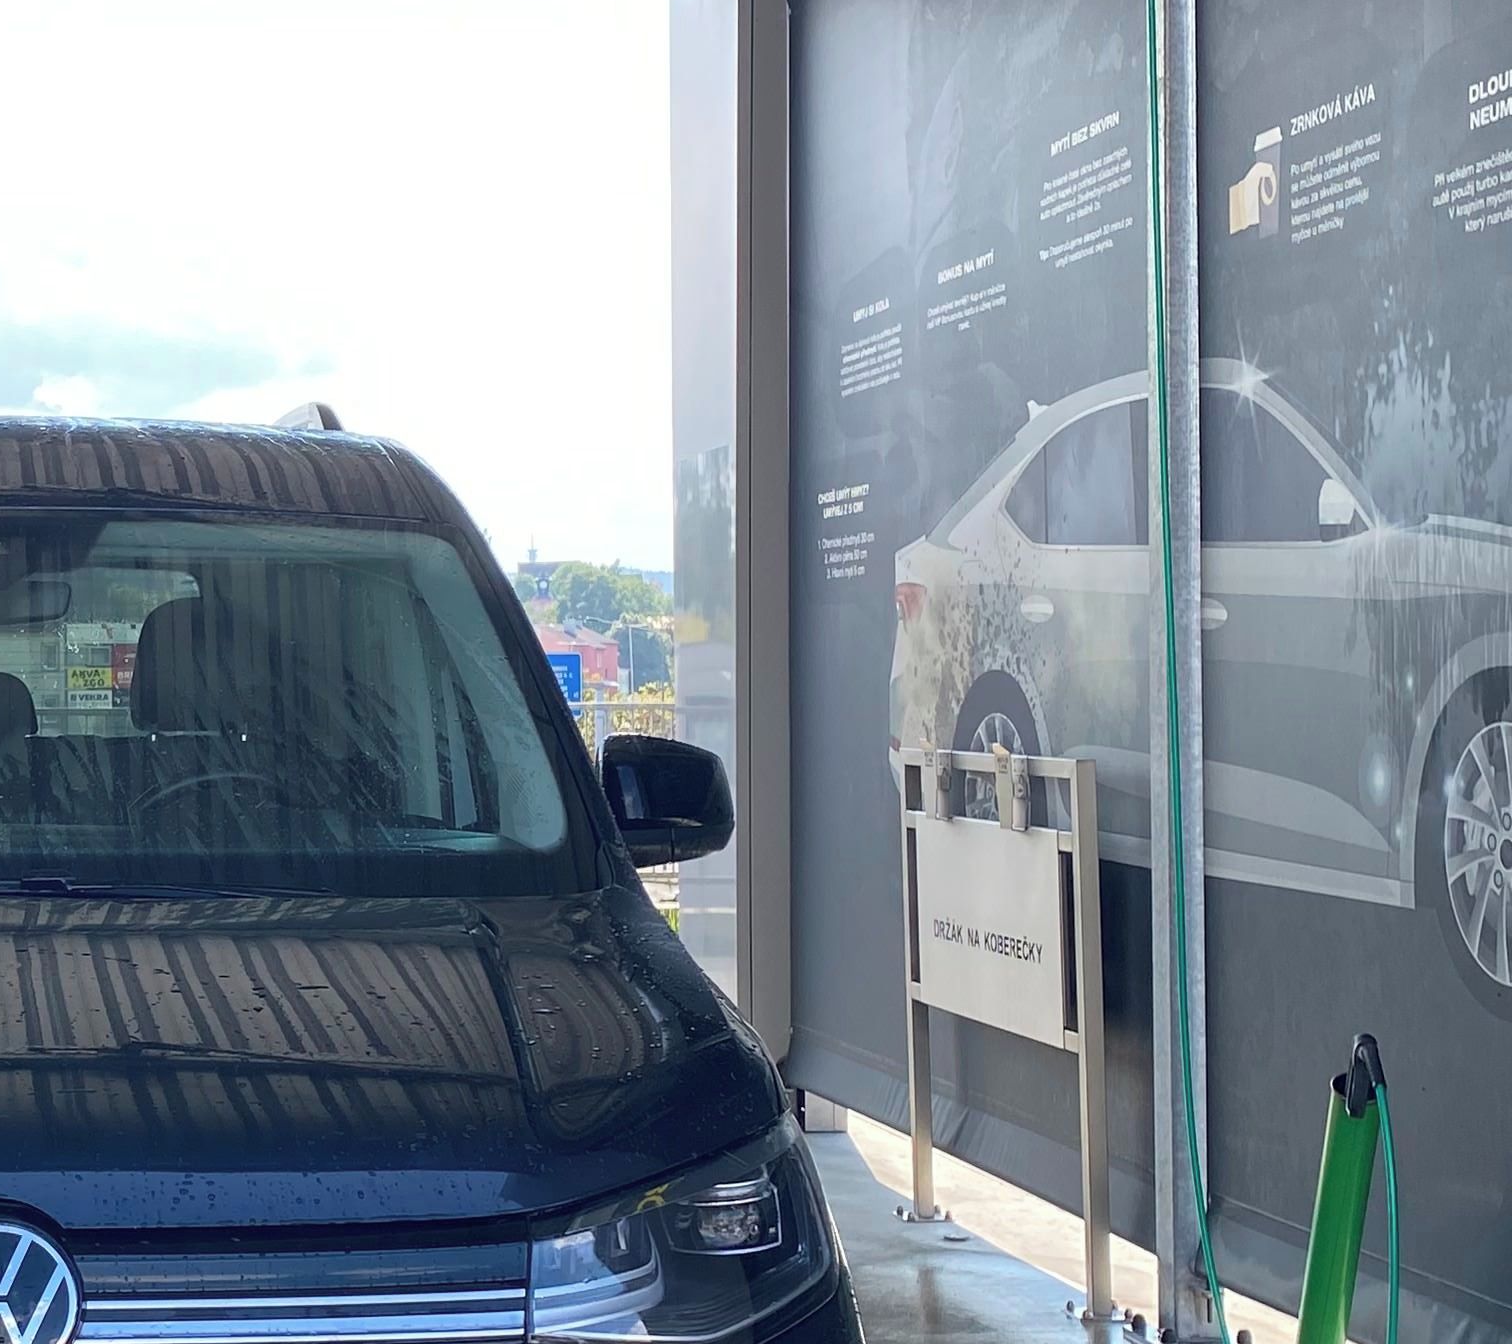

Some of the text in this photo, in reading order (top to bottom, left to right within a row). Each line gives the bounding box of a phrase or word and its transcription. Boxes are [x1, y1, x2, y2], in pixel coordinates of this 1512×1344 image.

[1468, 69, 1512, 104] DLOU
[1290, 83, 1376, 136] ZRNKOVÁ KÁVA
[1050, 110, 1120, 157] MYTÍ BEZ SKVRN
[937, 248, 994, 285] BONUS NA MYTÍ
[818, 488, 835, 505] CHCEŠ
[934, 917, 1043, 964] DRŽÁK NA KOBEREČKY
